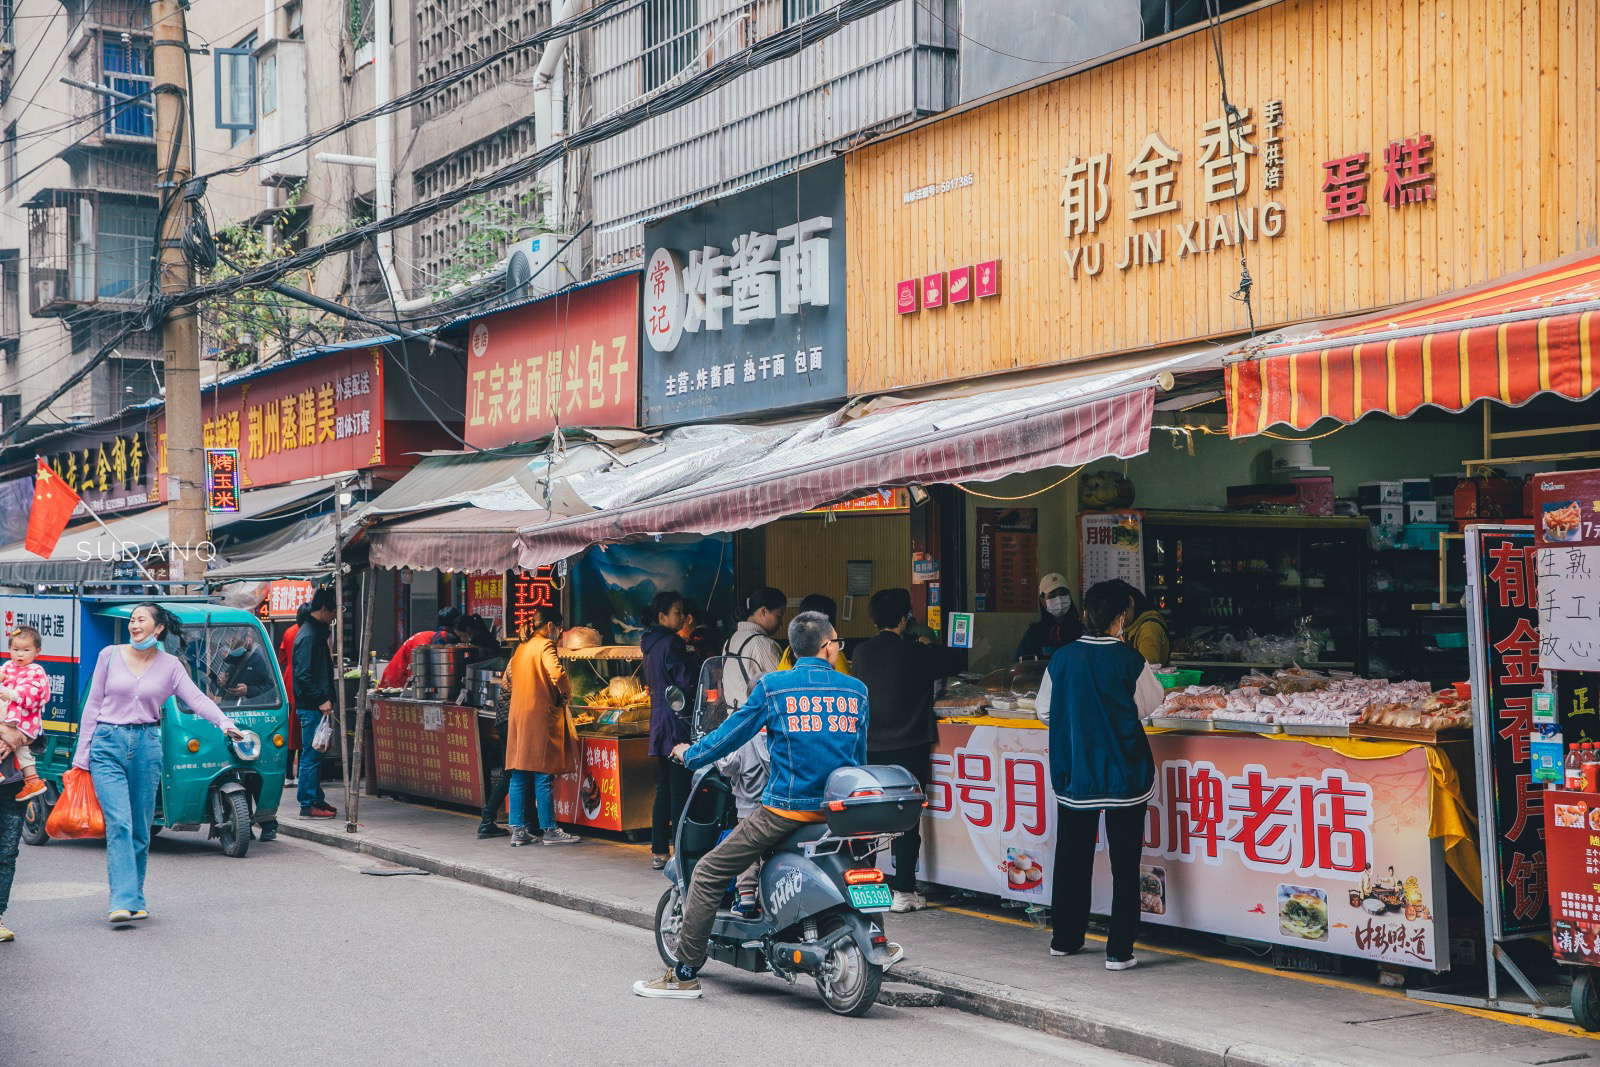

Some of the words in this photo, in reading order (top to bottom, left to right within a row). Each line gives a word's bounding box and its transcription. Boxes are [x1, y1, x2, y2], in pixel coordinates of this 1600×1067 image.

[1264, 100, 1282, 190] 手工烘焙
[1060, 108, 1258, 238] 郁金香
[1322, 135, 1437, 222] 蛋糕
[1063, 243, 1104, 279] YU
[1115, 230, 1164, 270] JIN
[1178, 201, 1285, 258] XIANG
[649, 260, 671, 334] 常记
[683, 215, 832, 333] 炸酱面
[336, 371, 370, 401] 外卖配送
[470, 335, 629, 427] 正宗老面馒头包子
[743, 353, 785, 382] 热干面
[795, 346, 823, 374] 包面
[248, 382, 336, 460] 荆州蒸膳美
[336, 410, 370, 439] 团体订餐
[212, 454, 235, 508] 烤玉米
[980, 523, 991, 570] 广式月饼
[1086, 526, 1111, 545] 月饼
[1538, 547, 1591, 579] 生熟
[785, 696, 859, 714] BOSTON
[787, 715, 822, 732] RED
[828, 715, 857, 732] SOX
[602, 778, 616, 797] 10元
[853, 890, 891, 906] B05399
